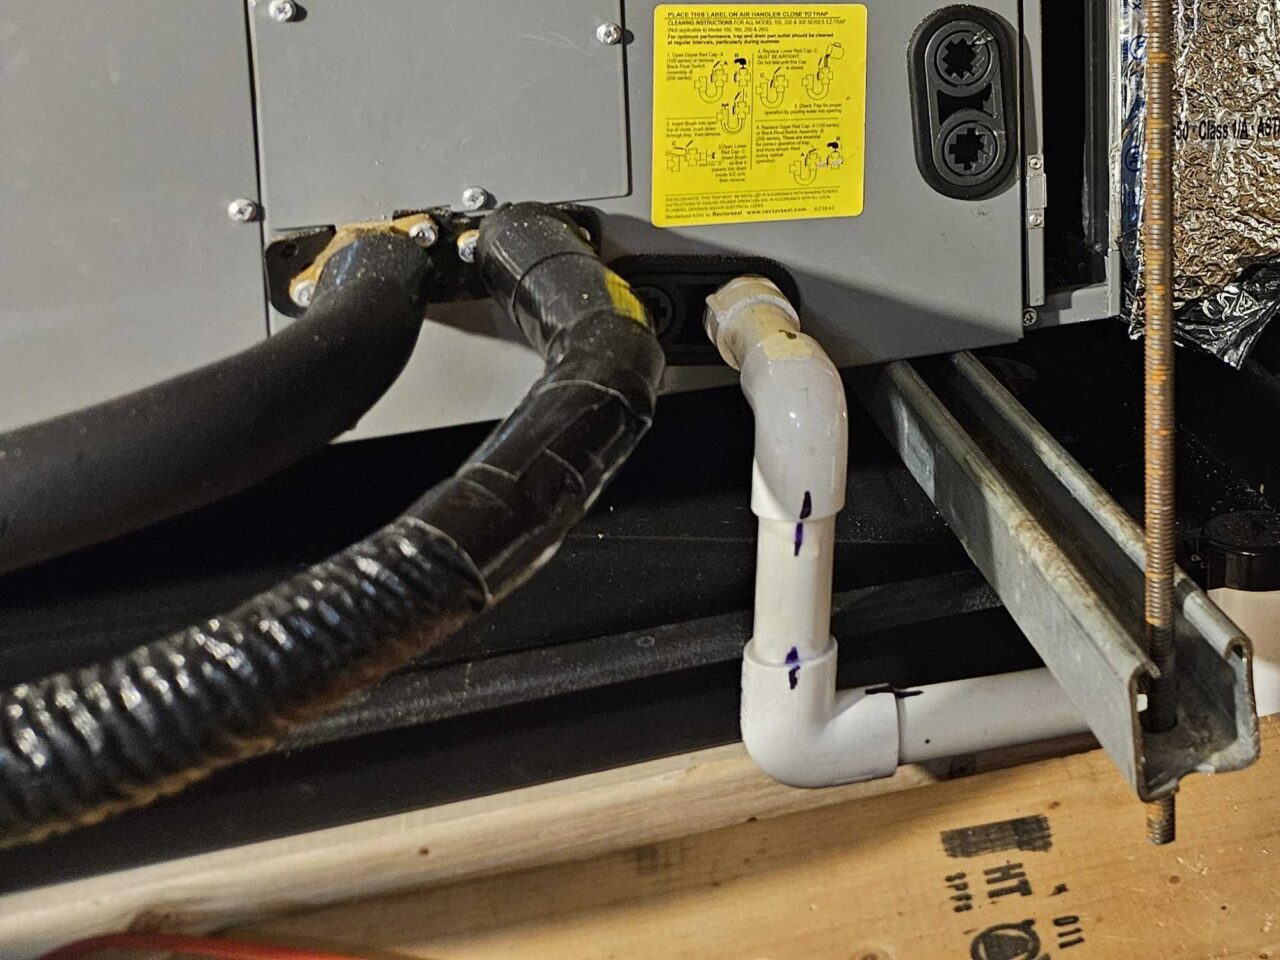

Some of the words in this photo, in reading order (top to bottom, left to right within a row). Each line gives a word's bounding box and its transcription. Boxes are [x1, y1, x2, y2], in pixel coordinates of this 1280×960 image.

[1199, 120, 1228, 140] Class
[983, 862, 1033, 898] HT
[1053, 915, 1086, 949] 011
